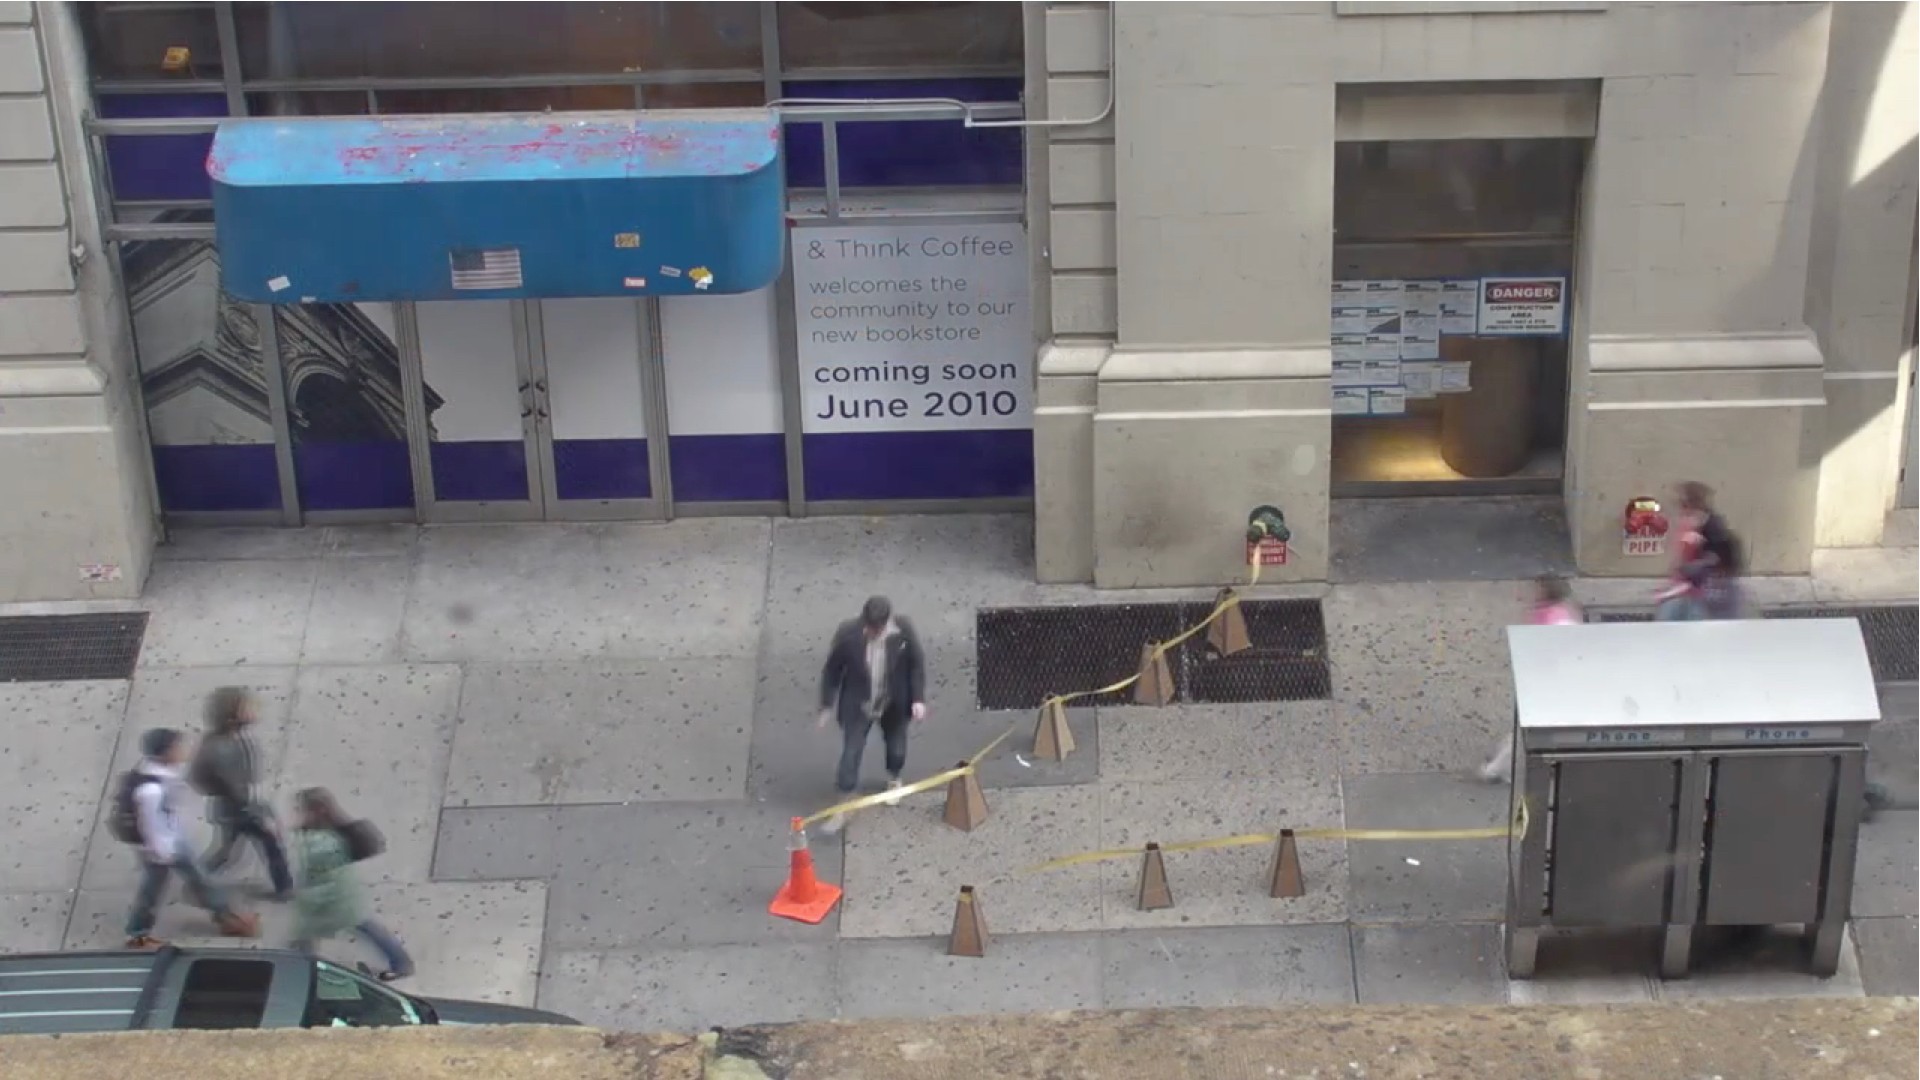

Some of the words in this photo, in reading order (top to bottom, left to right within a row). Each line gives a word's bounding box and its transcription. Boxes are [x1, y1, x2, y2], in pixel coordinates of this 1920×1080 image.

[807, 240, 826, 259] &
[837, 237, 910, 258] Think
[921, 236, 1014, 257] Coffee
[809, 277, 922, 294] welcomes
[931, 276, 967, 292] the
[1493, 288, 1554, 298] DANGER
[810, 301, 938, 320] community
[948, 302, 970, 316] to
[978, 301, 1016, 315] our
[811, 330, 858, 343] new
[867, 325, 980, 342] bookstore
[814, 361, 930, 385] coming
[942, 362, 1016, 380] soon
[817, 395, 909, 419] June
[924, 390, 1017, 417] 2010
[1585, 730, 1651, 742] Phone
[1745, 728, 1810, 740] Phone
